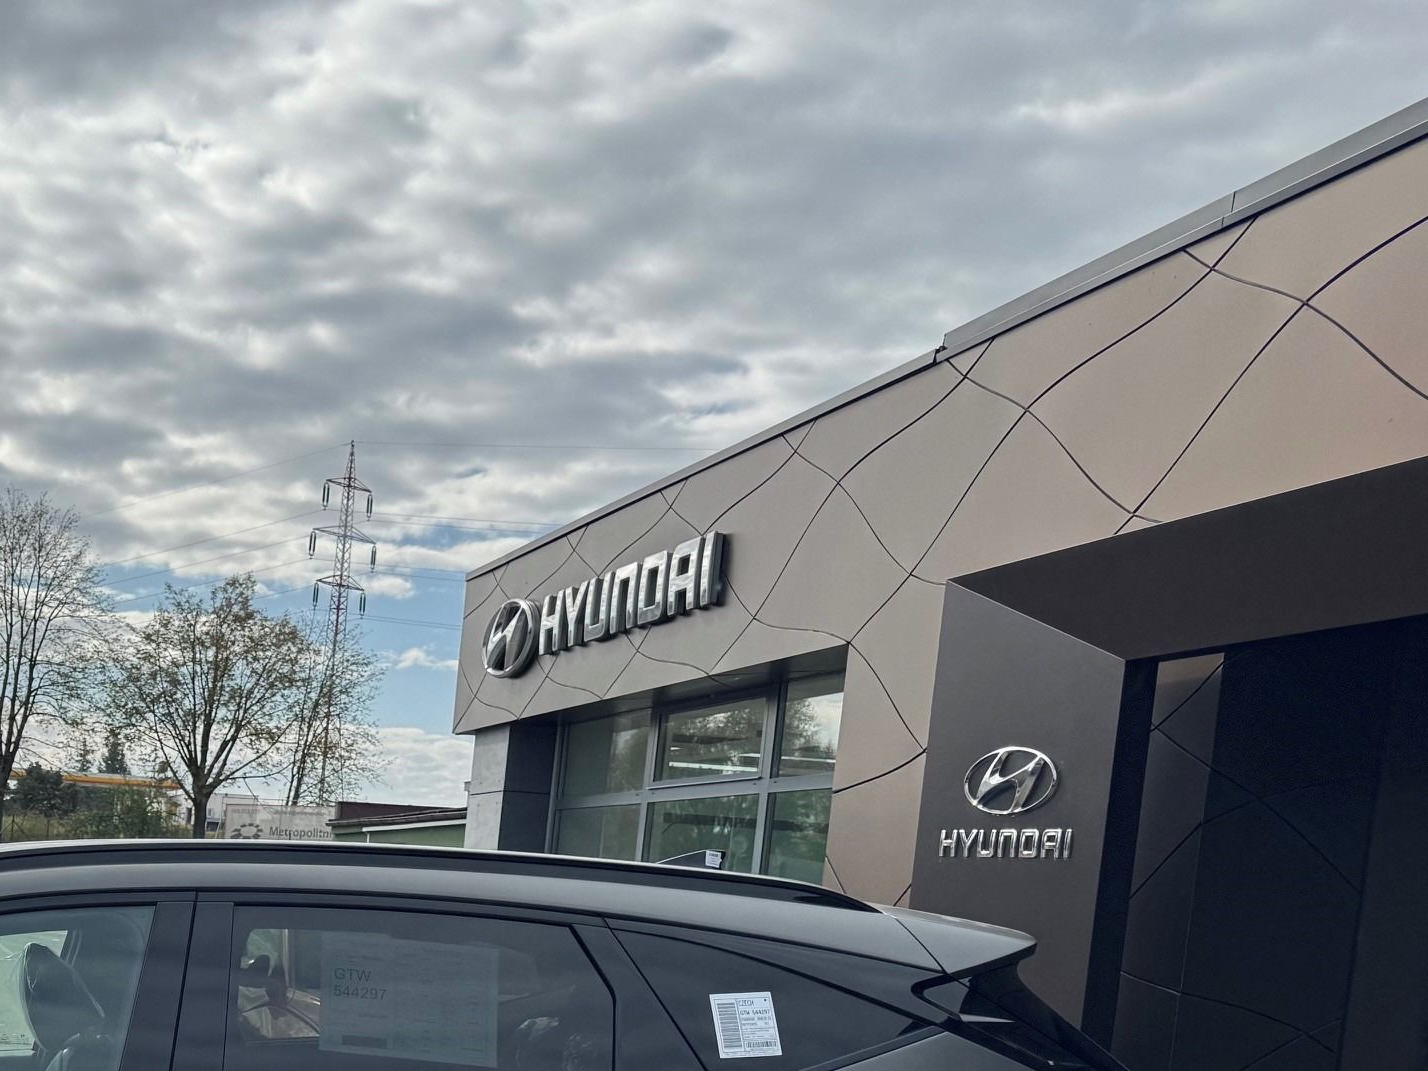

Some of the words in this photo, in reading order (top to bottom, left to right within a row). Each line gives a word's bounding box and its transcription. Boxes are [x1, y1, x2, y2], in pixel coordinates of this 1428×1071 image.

[538, 530, 723, 656] HYUNDAI
[938, 828, 1073, 859] HYUNDAI
[334, 967, 372, 982] GTW
[333, 984, 387, 1000] 544297
